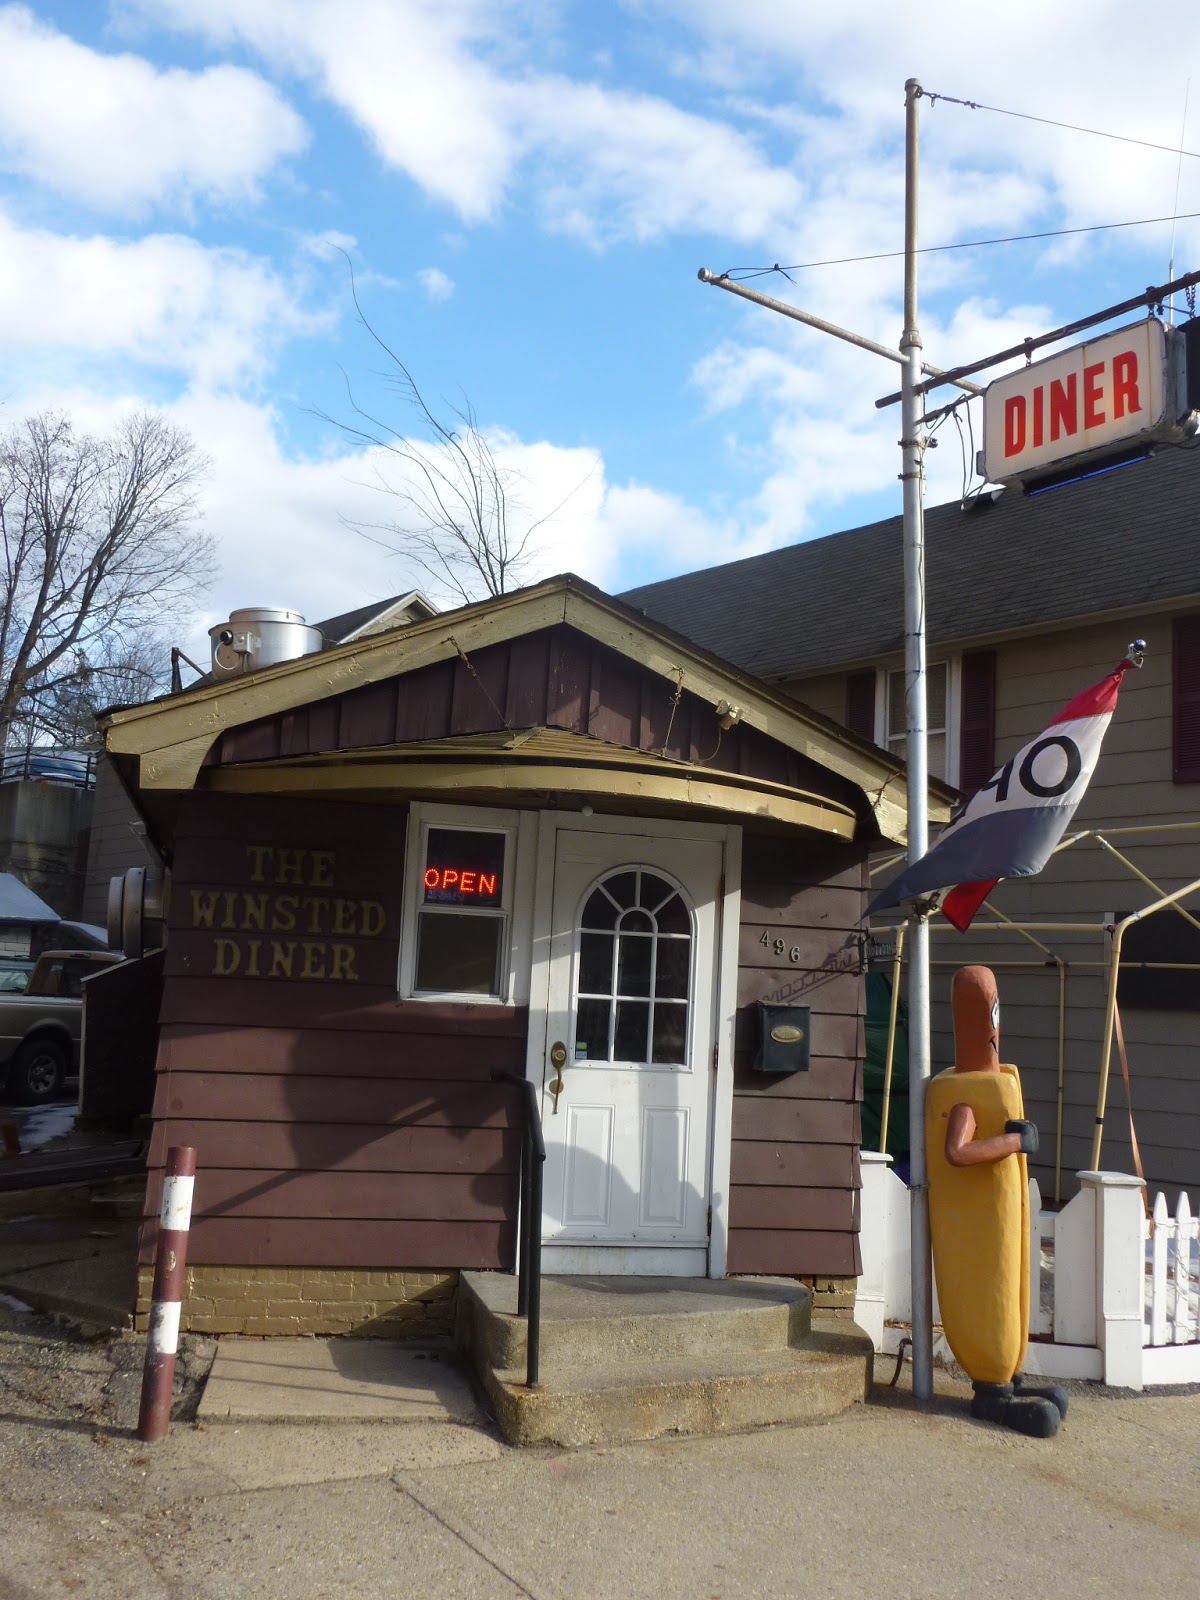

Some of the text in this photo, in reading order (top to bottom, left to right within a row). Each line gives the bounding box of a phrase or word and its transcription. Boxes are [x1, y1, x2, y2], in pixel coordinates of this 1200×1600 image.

[1004, 350, 1142, 459] DINER
[246, 845, 337, 887] THE
[424, 868, 496, 894] OPEN
[190, 889, 386, 937] WINSTED
[212, 938, 360, 981] DINER
[760, 930, 801, 962] 496
